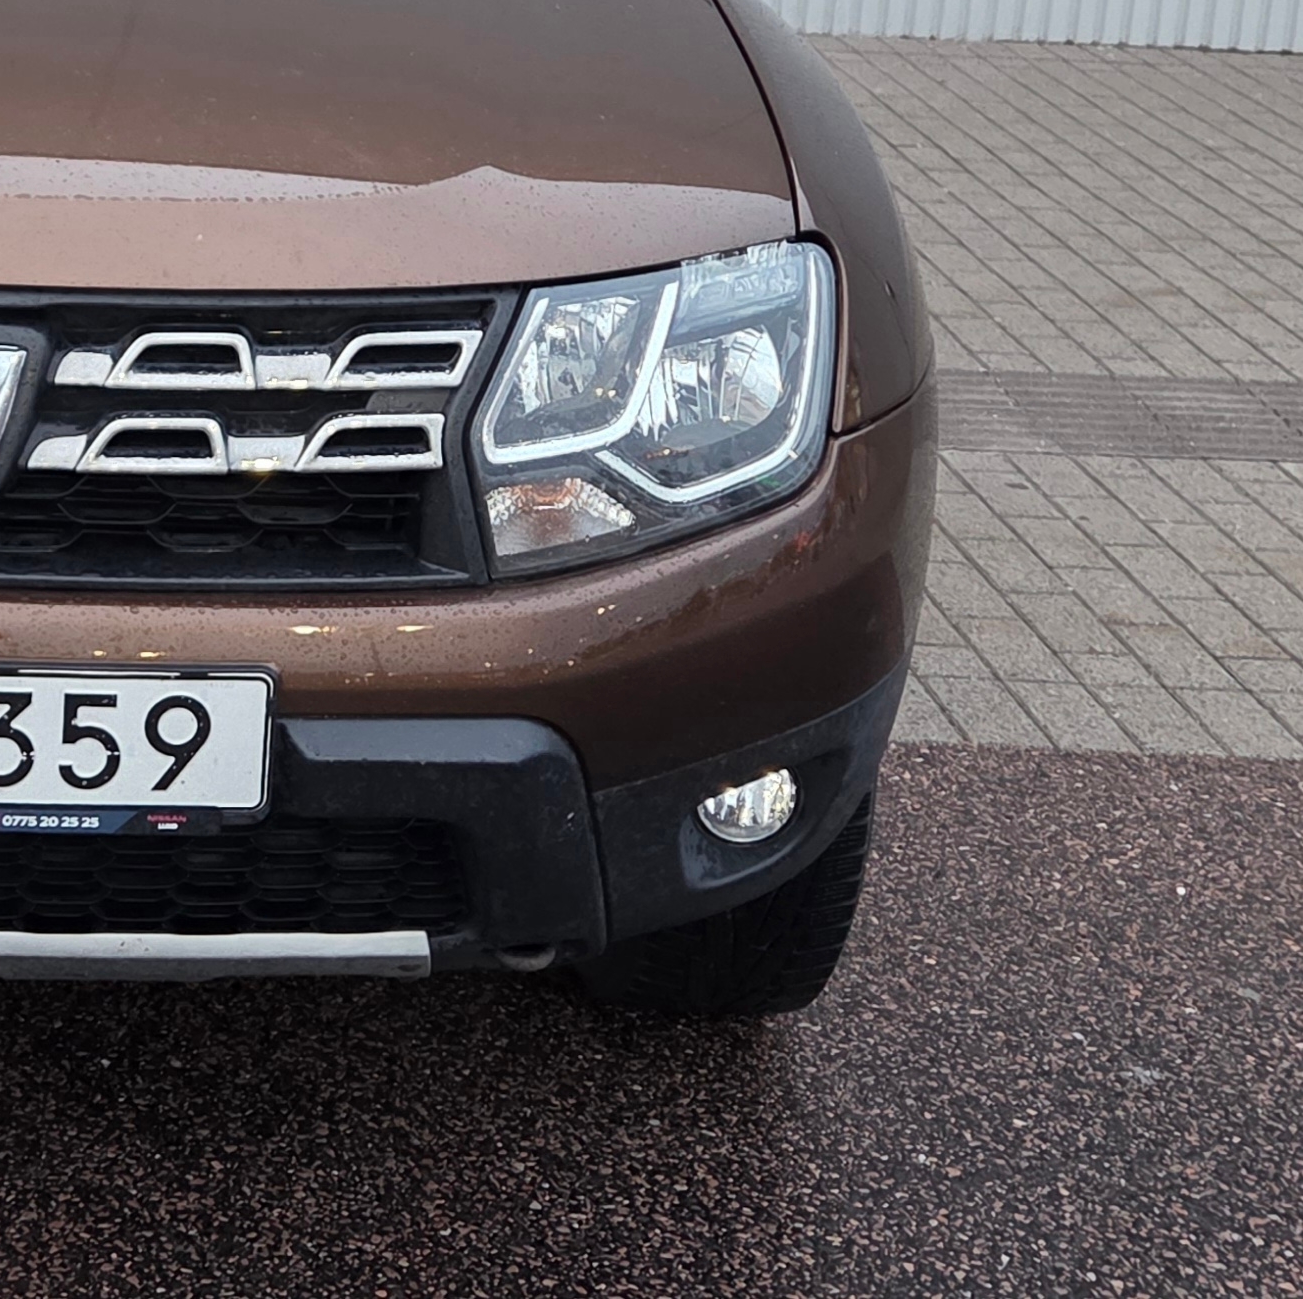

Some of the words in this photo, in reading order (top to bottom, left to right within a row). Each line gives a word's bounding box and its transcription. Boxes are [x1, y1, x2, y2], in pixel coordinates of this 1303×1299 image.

[1, 814, 38, 828] 0775
[39, 815, 59, 828] 20
[60, 815, 81, 829] 25
[81, 816, 100, 829] 25
